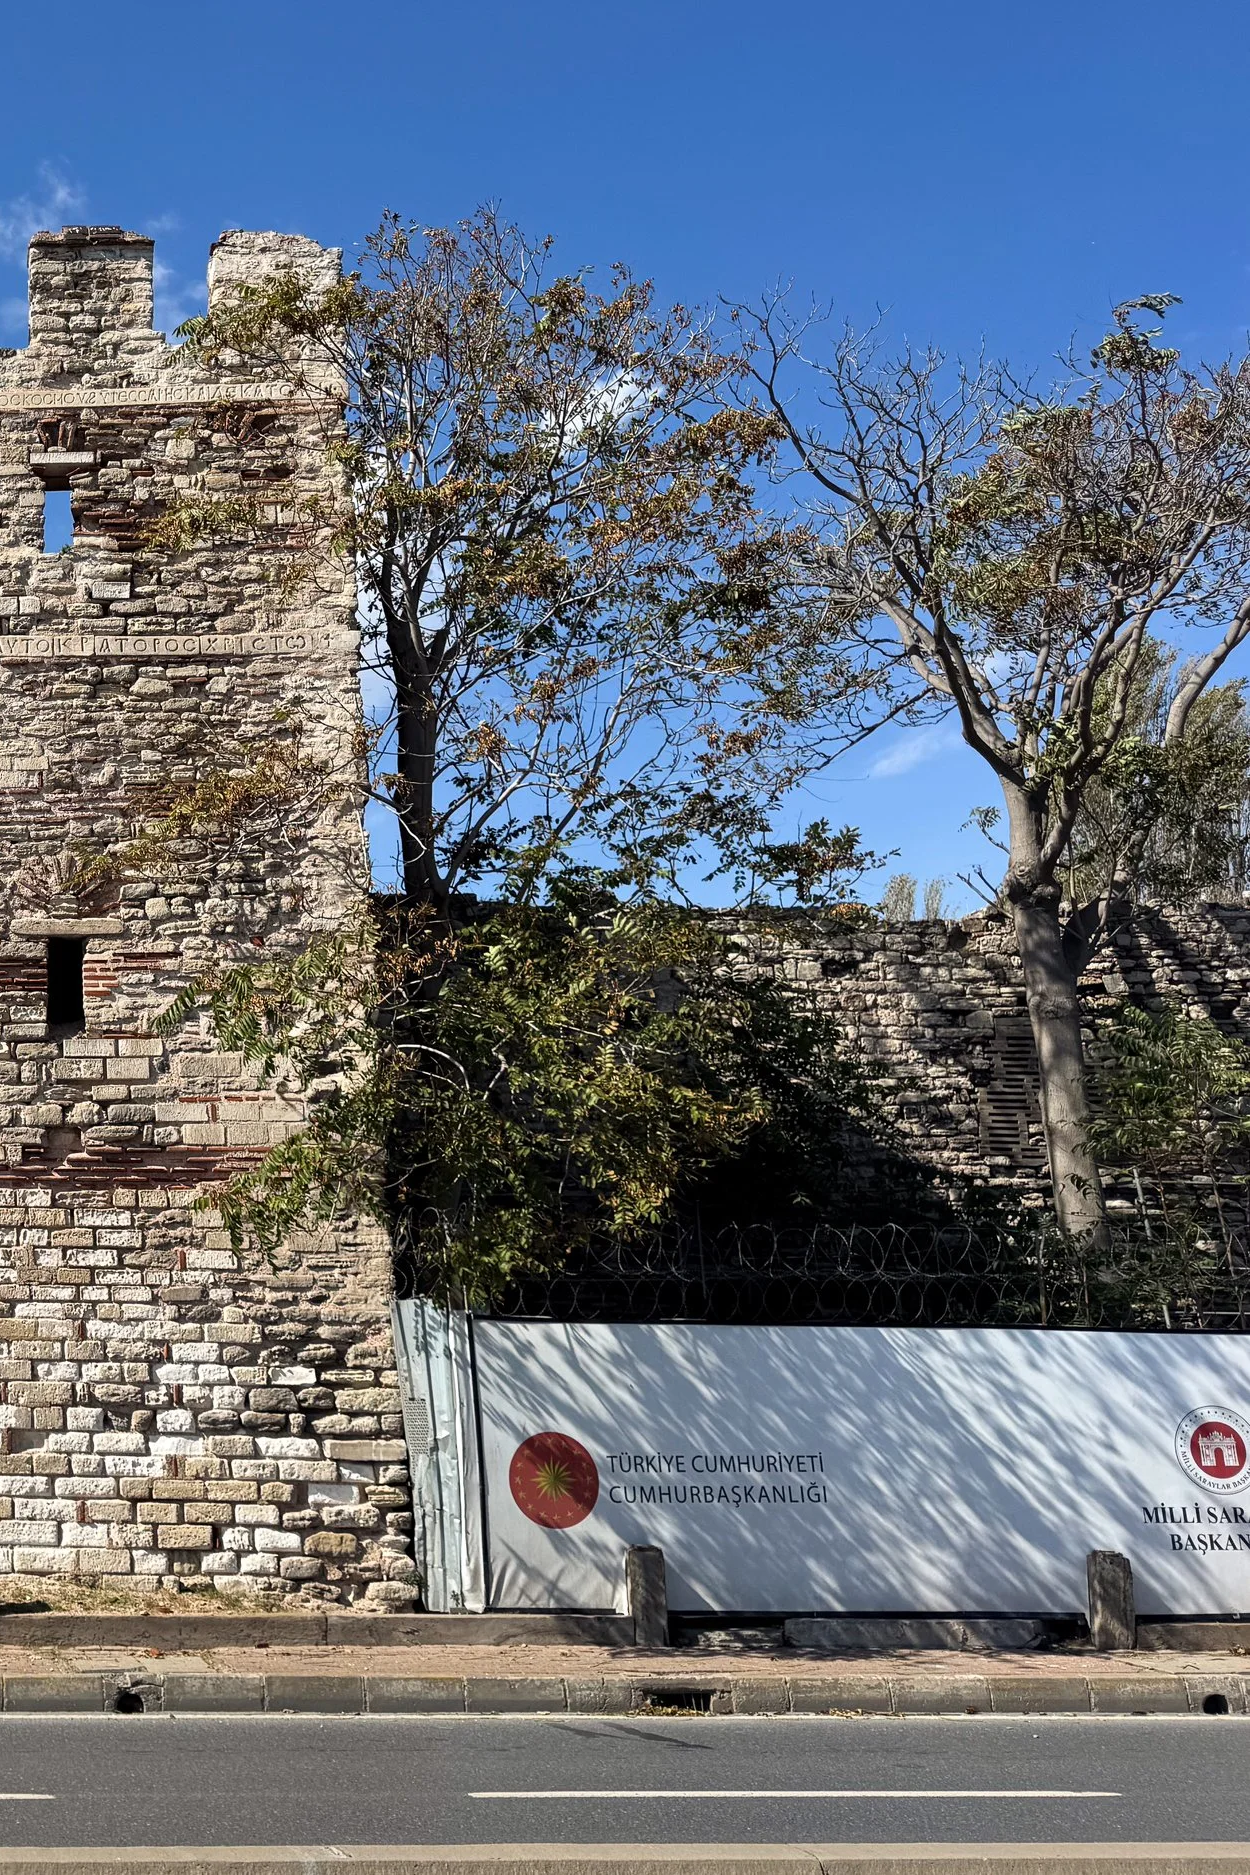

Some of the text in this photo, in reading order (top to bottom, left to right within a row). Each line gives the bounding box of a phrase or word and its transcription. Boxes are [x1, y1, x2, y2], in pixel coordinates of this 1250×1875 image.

[606, 1451, 824, 1474] TÜRKİYE CUMHURİYETİ
[1193, 1472, 1231, 1490] SARAYLAR
[609, 1481, 827, 1508] CUMHURBAŞKANLIĞI
[1142, 1502, 1250, 1524] MİLLİ SAR
